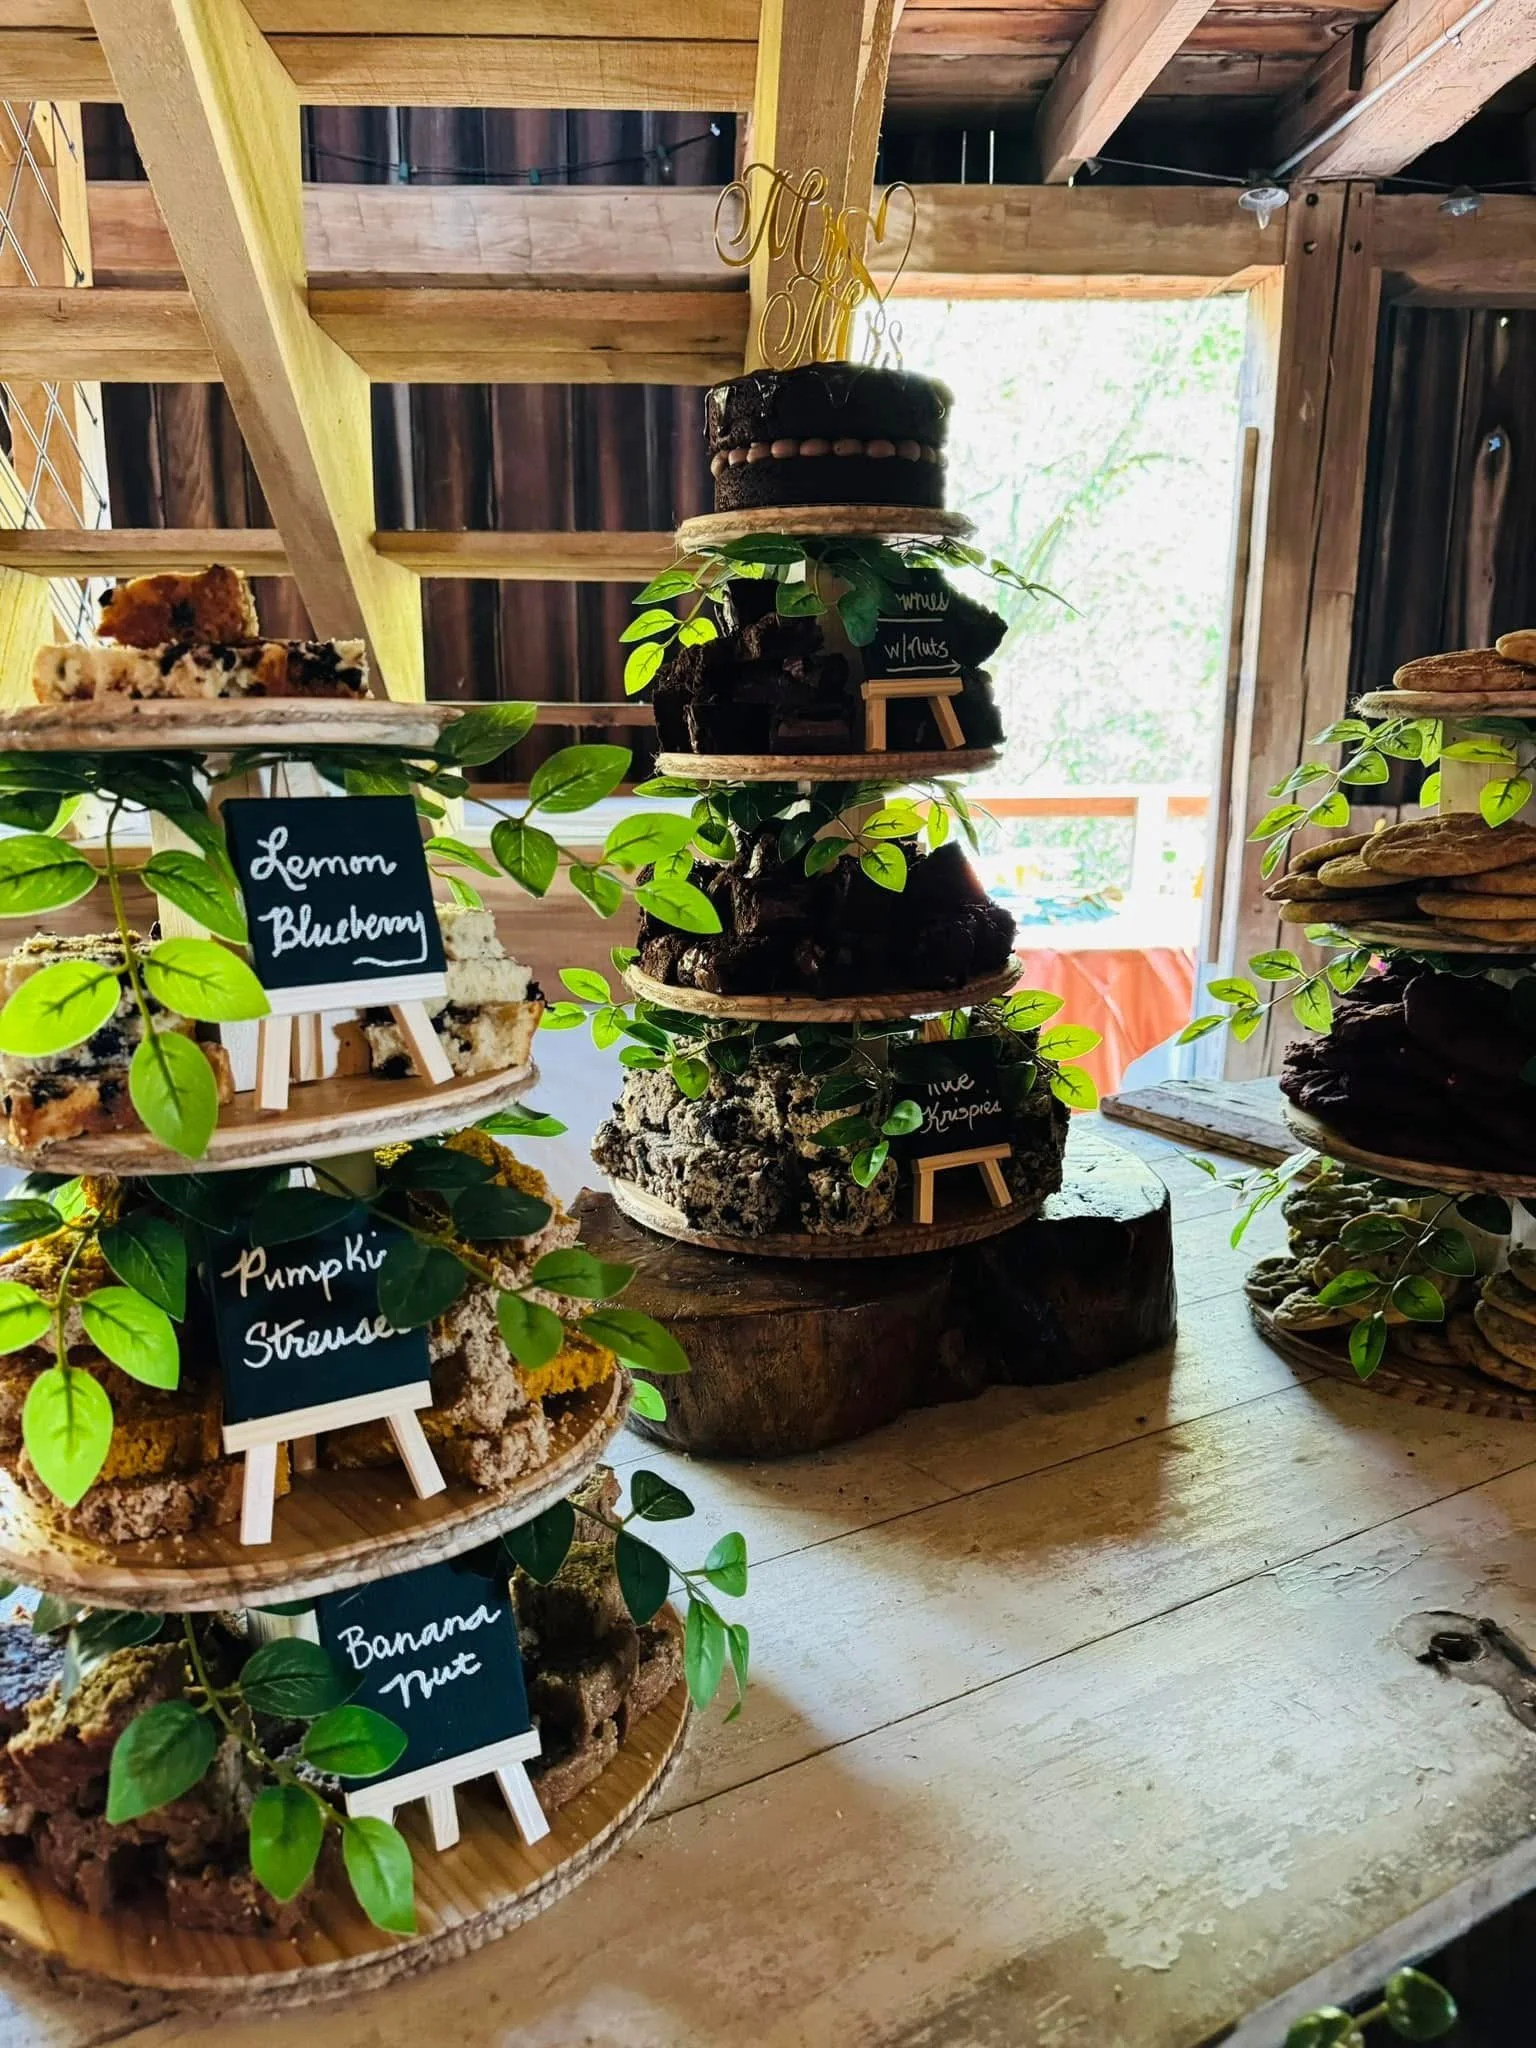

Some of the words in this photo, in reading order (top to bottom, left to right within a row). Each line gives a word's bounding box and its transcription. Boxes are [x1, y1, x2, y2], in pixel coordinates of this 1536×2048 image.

[250, 826, 398, 892] Lemon
[258, 903, 428, 967] Blueberry
[920, 1089, 1002, 1134] Krispies
[221, 1231, 388, 1302] Pumpki
[243, 1318, 412, 1369] Streuse
[337, 1604, 502, 1670] Banana
